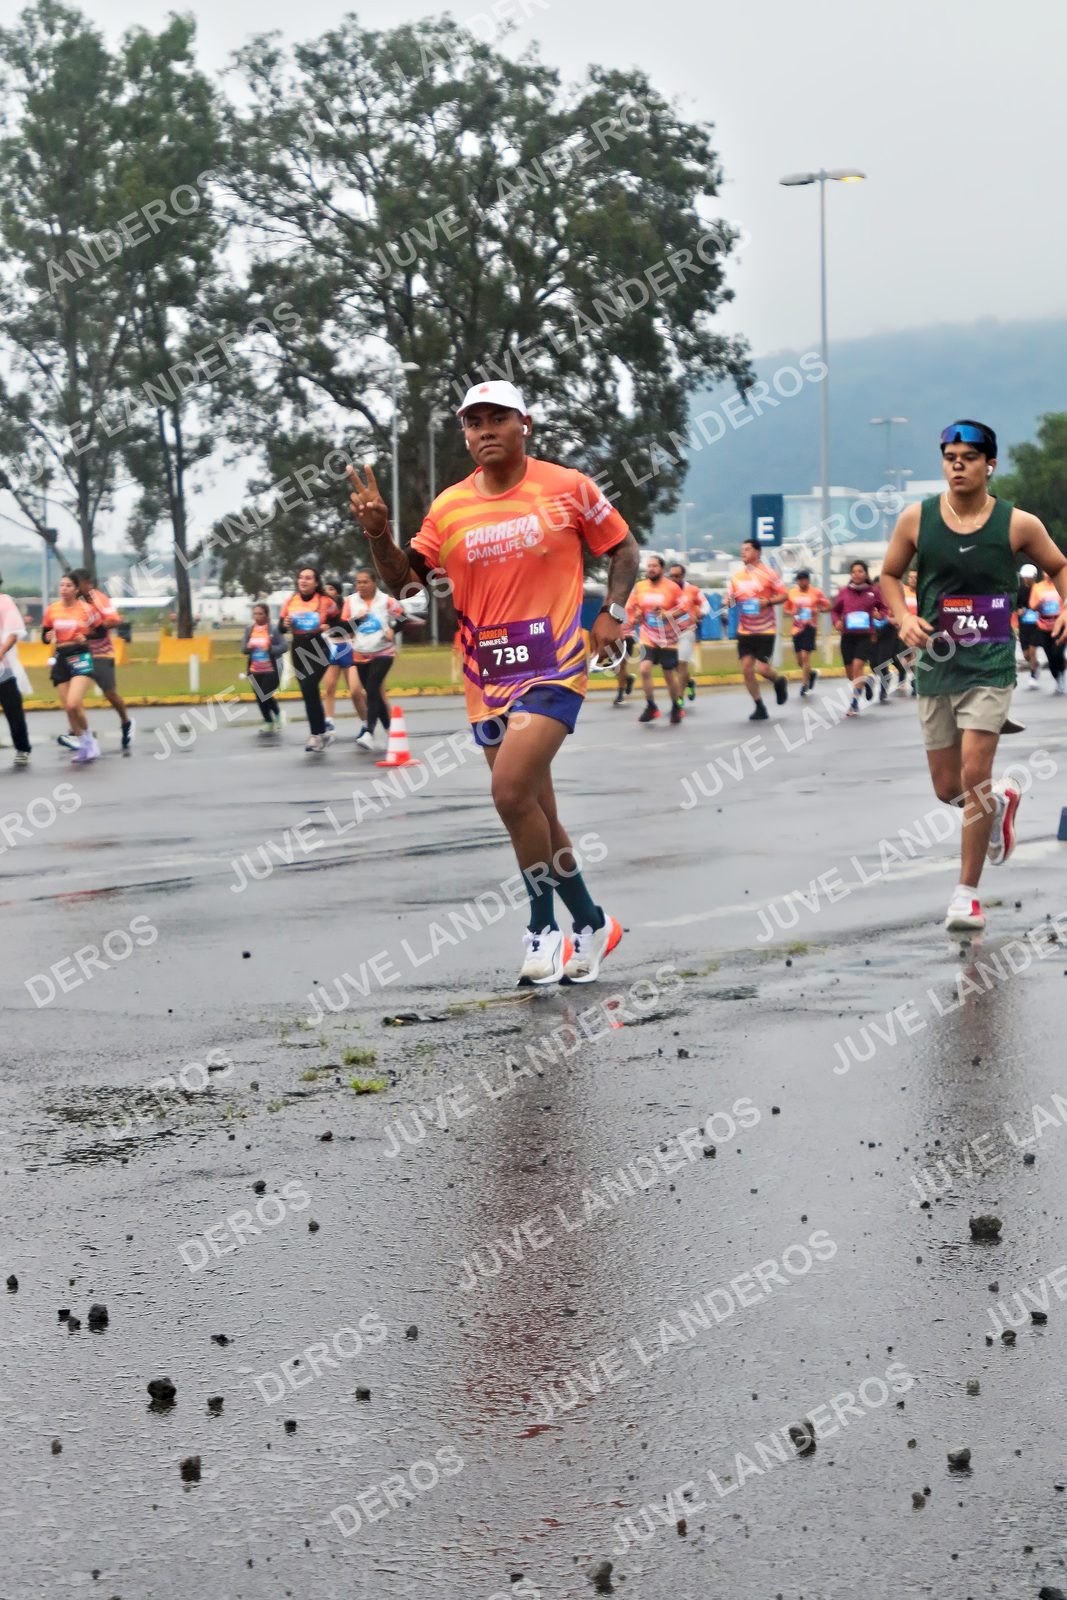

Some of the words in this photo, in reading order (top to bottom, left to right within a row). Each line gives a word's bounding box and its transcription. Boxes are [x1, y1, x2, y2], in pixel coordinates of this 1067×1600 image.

[465, 513, 539, 549] CARRERA
[757, 516, 775, 540] E
[467, 538, 522, 563] OMNILIFE
[529, 622, 545, 635] 15K
[957, 615, 988, 630] 744
[479, 628, 508, 641] CARRERA
[479, 638, 502, 647] OMNILIFE
[492, 645, 529, 665] 738
